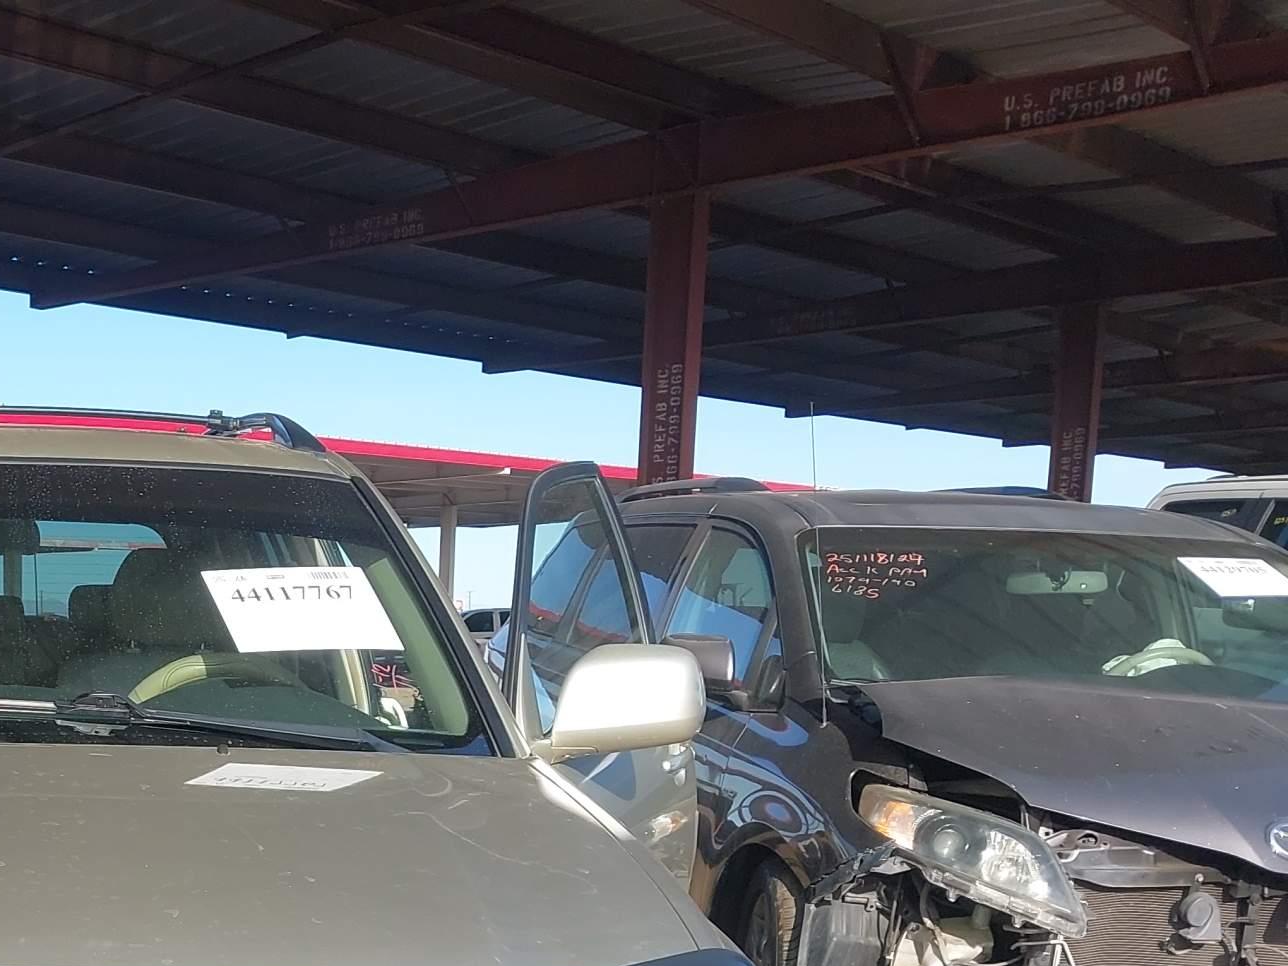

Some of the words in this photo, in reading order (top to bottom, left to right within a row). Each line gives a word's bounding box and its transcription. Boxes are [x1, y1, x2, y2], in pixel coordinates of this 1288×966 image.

[1048, 75, 1125, 106] PREFAB
[653, 402, 668, 463] PREFAB
[231, 584, 353, 602] 44117767
